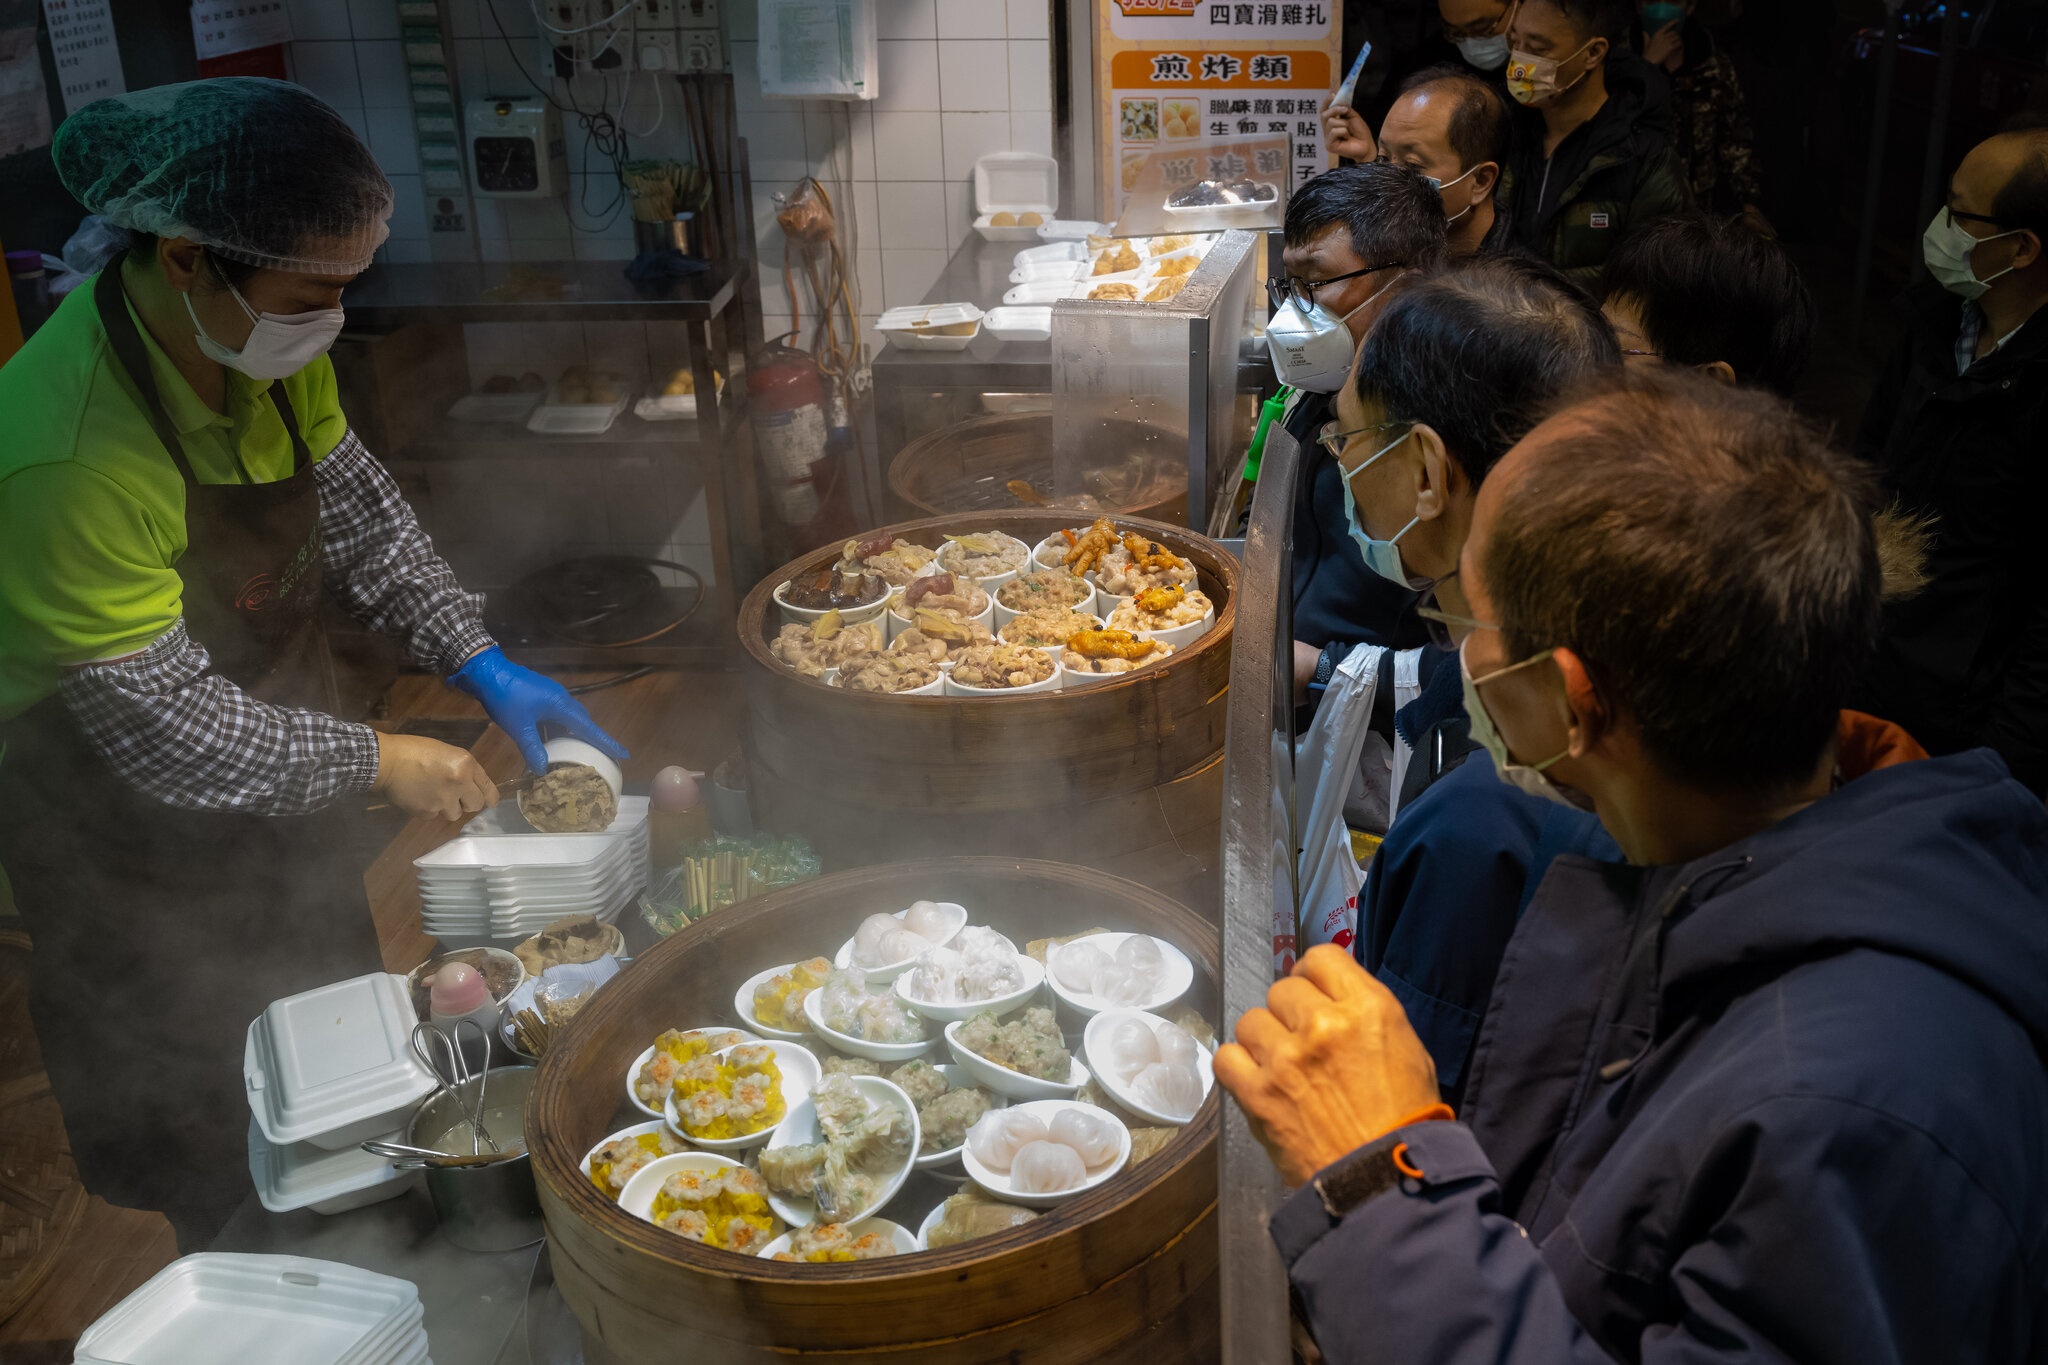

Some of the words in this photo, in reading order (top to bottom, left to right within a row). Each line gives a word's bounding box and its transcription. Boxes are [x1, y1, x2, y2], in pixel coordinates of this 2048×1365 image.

[1210, 4, 1327, 25] 四寶滑雞扎
[1152, 56, 1290, 79] 煎炸類
